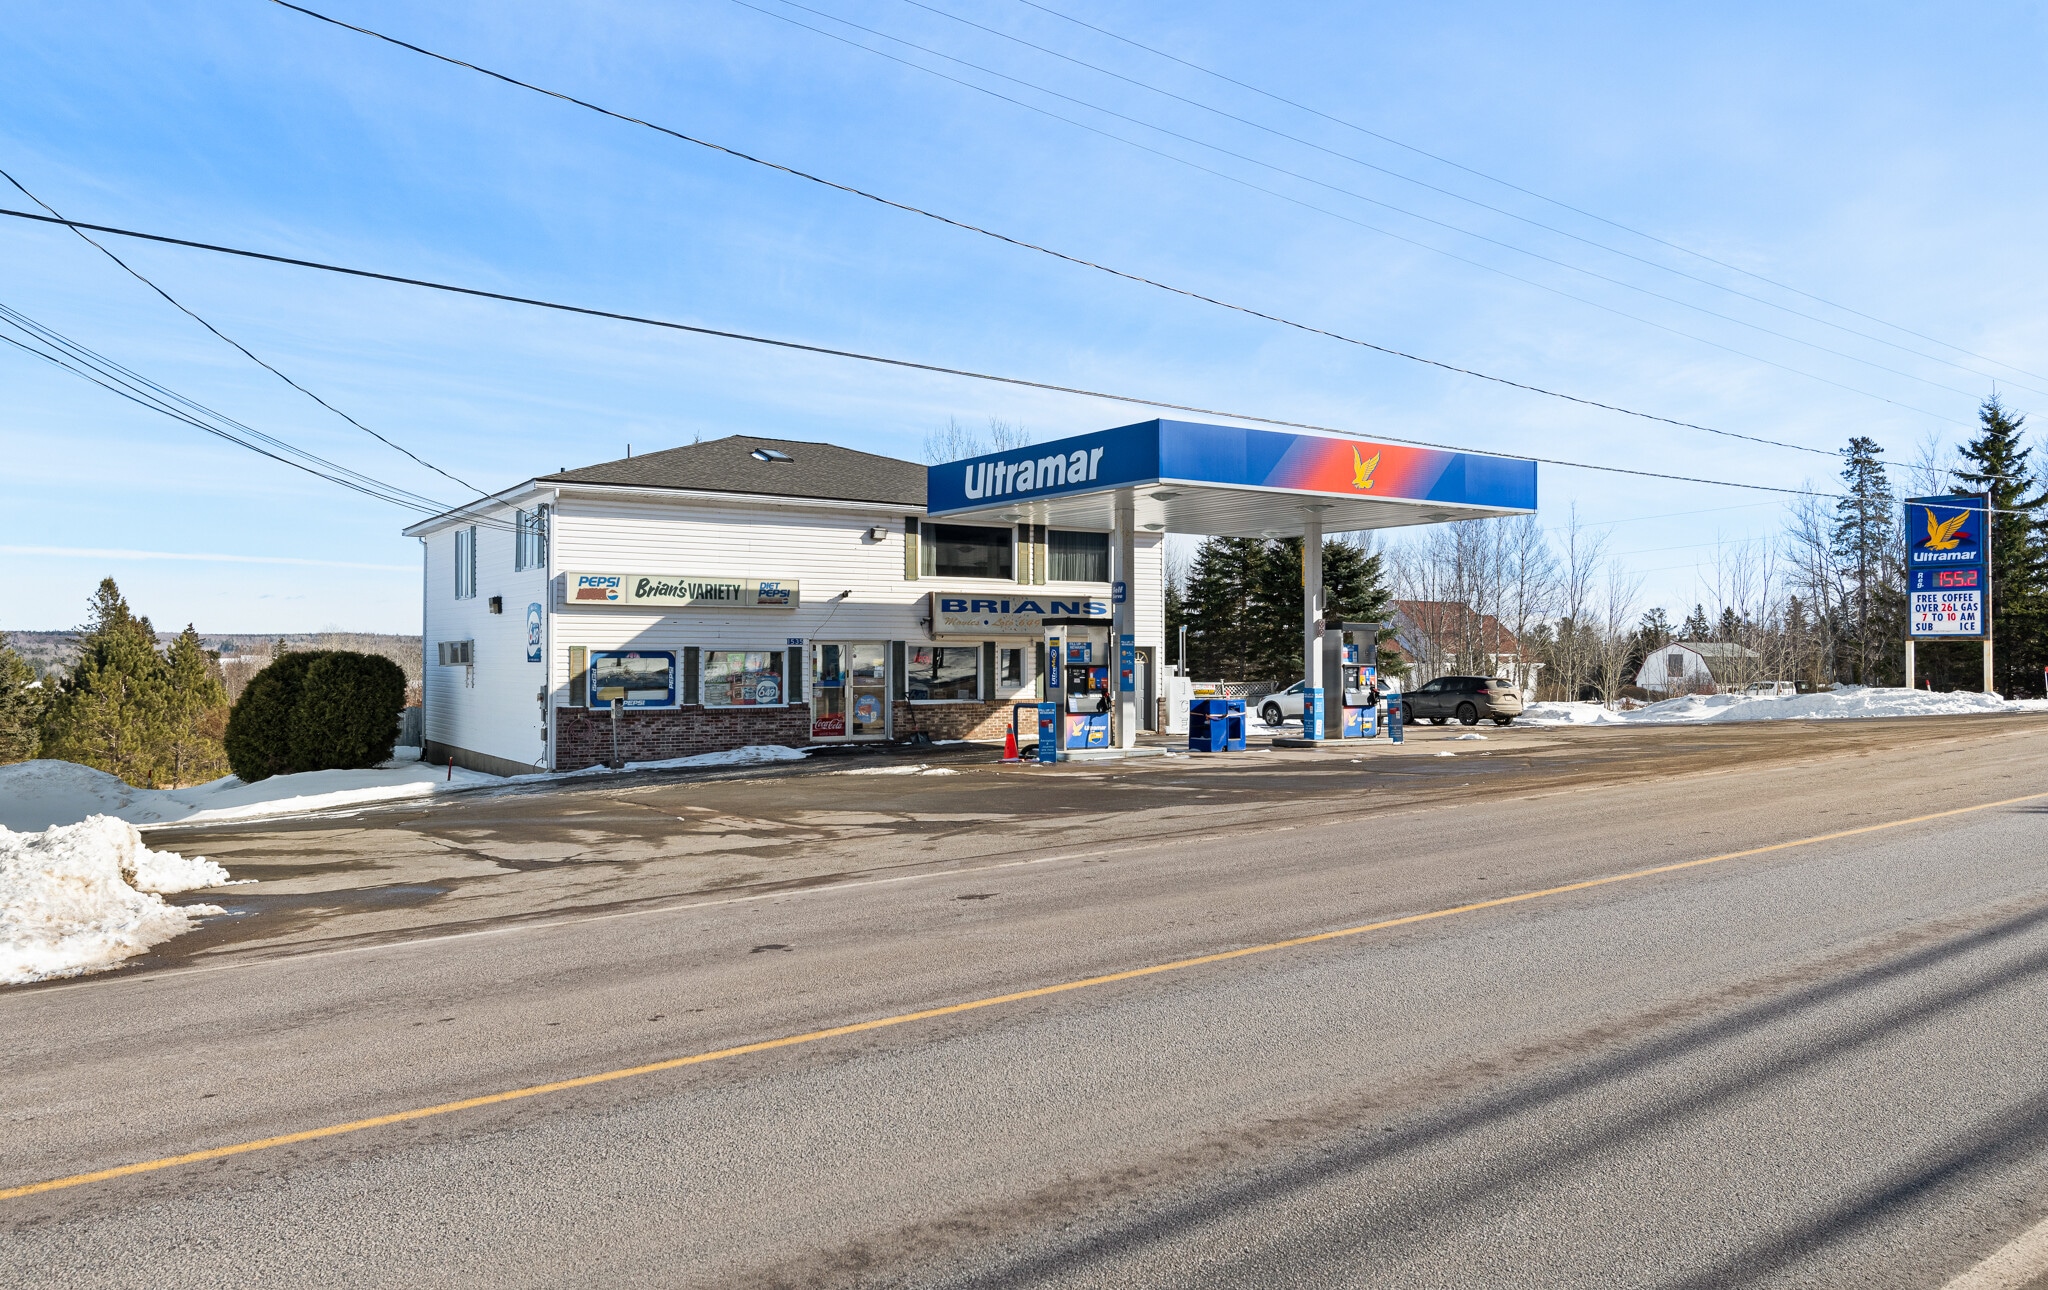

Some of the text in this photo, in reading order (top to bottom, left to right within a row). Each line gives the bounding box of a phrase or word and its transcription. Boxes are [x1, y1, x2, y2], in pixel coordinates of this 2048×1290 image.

[964, 446, 1104, 500] Ultramar
[1913, 551, 1977, 562] Ultramar
[578, 576, 620, 587] PEPSI
[1939, 570, 1978, 587] 155.2
[635, 577, 741, 601] Brian's VARIETY
[759, 582, 781, 590] DIET
[758, 589, 791, 598] PEPSI
[1917, 593, 1974, 603] FREE COFFEE
[941, 599, 1107, 615] BRIANS
[1915, 603, 1939, 613] OVER
[1961, 602, 1979, 611] GAS
[944, 617, 980, 626] Movies
[1922, 612, 1976, 621] 7 TO 10 AM
[1915, 622, 1976, 631] SUB ICE
